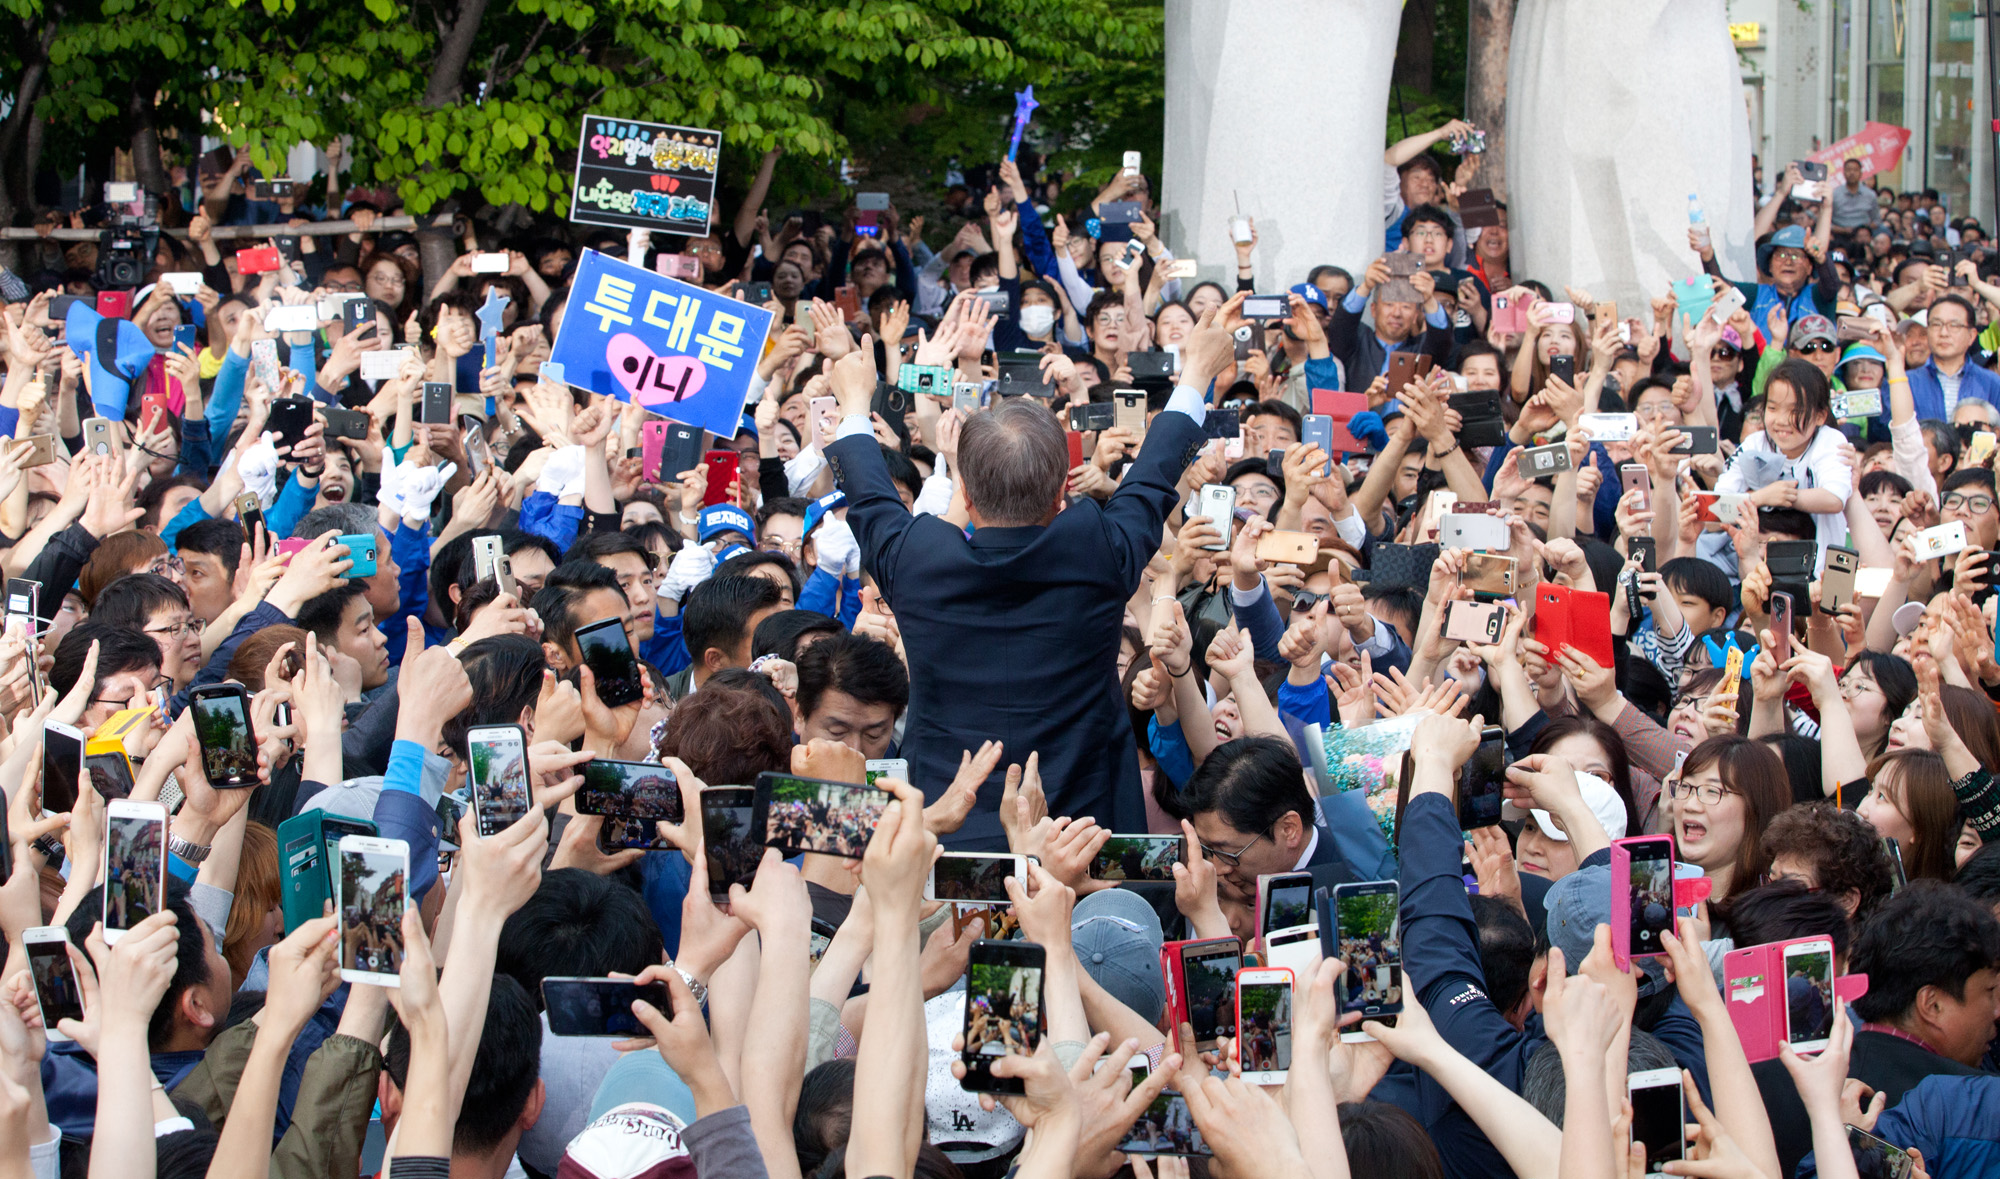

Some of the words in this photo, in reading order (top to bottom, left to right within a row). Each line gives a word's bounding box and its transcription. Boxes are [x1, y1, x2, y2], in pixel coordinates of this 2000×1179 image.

[590, 134, 652, 166] 잊지말자
[579, 177, 633, 213] 내손으로
[1305, 284, 1319, 301] LA
[622, 355, 694, 403] 이니
[706, 510, 749, 531] 문재인
[951, 1109, 976, 1132] LA
